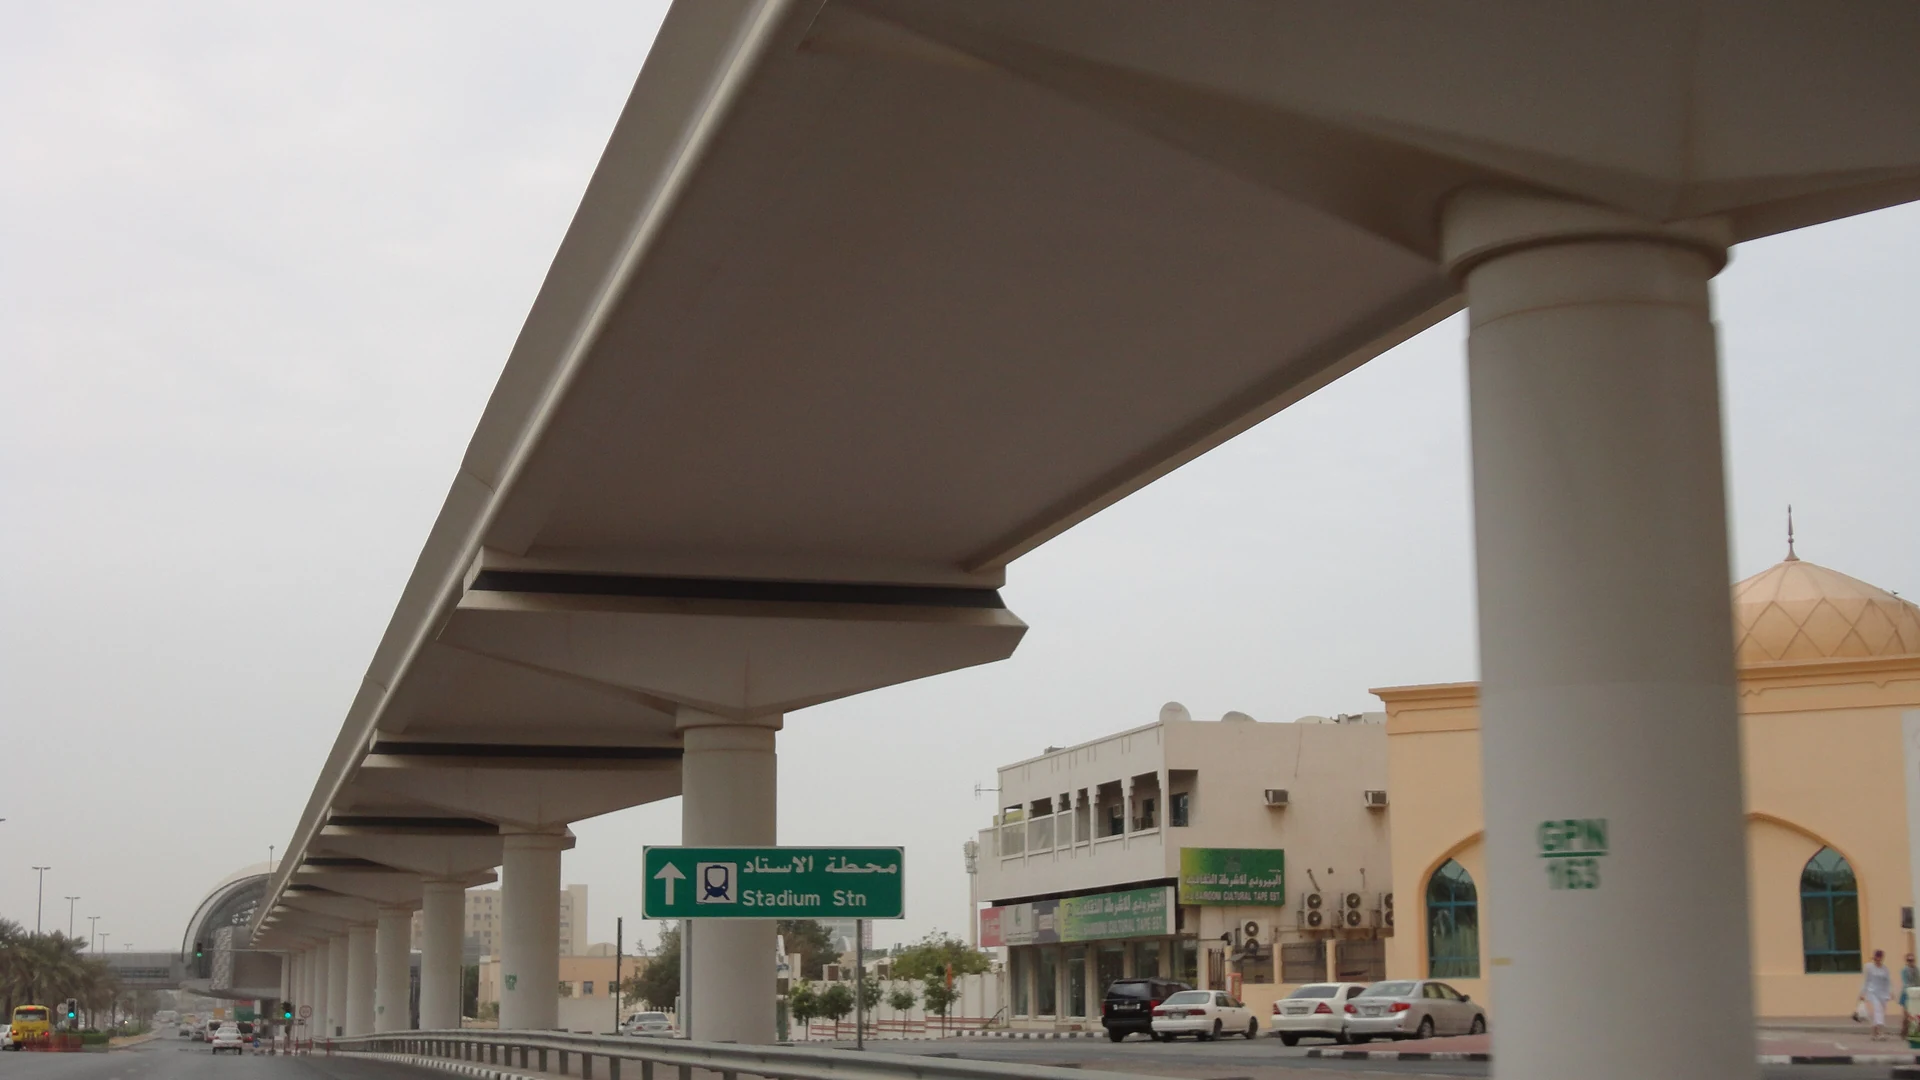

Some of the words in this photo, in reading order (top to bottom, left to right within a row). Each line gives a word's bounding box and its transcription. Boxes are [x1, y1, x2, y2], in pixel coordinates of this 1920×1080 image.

[1538, 819, 1608, 850] GPN
[825, 855, 898, 874] محطة
[743, 890, 820, 906] Stadium
[833, 890, 867, 906] Stn
[1223, 891, 1252, 901] CULTURAL
[1253, 891, 1268, 901] TAPE
